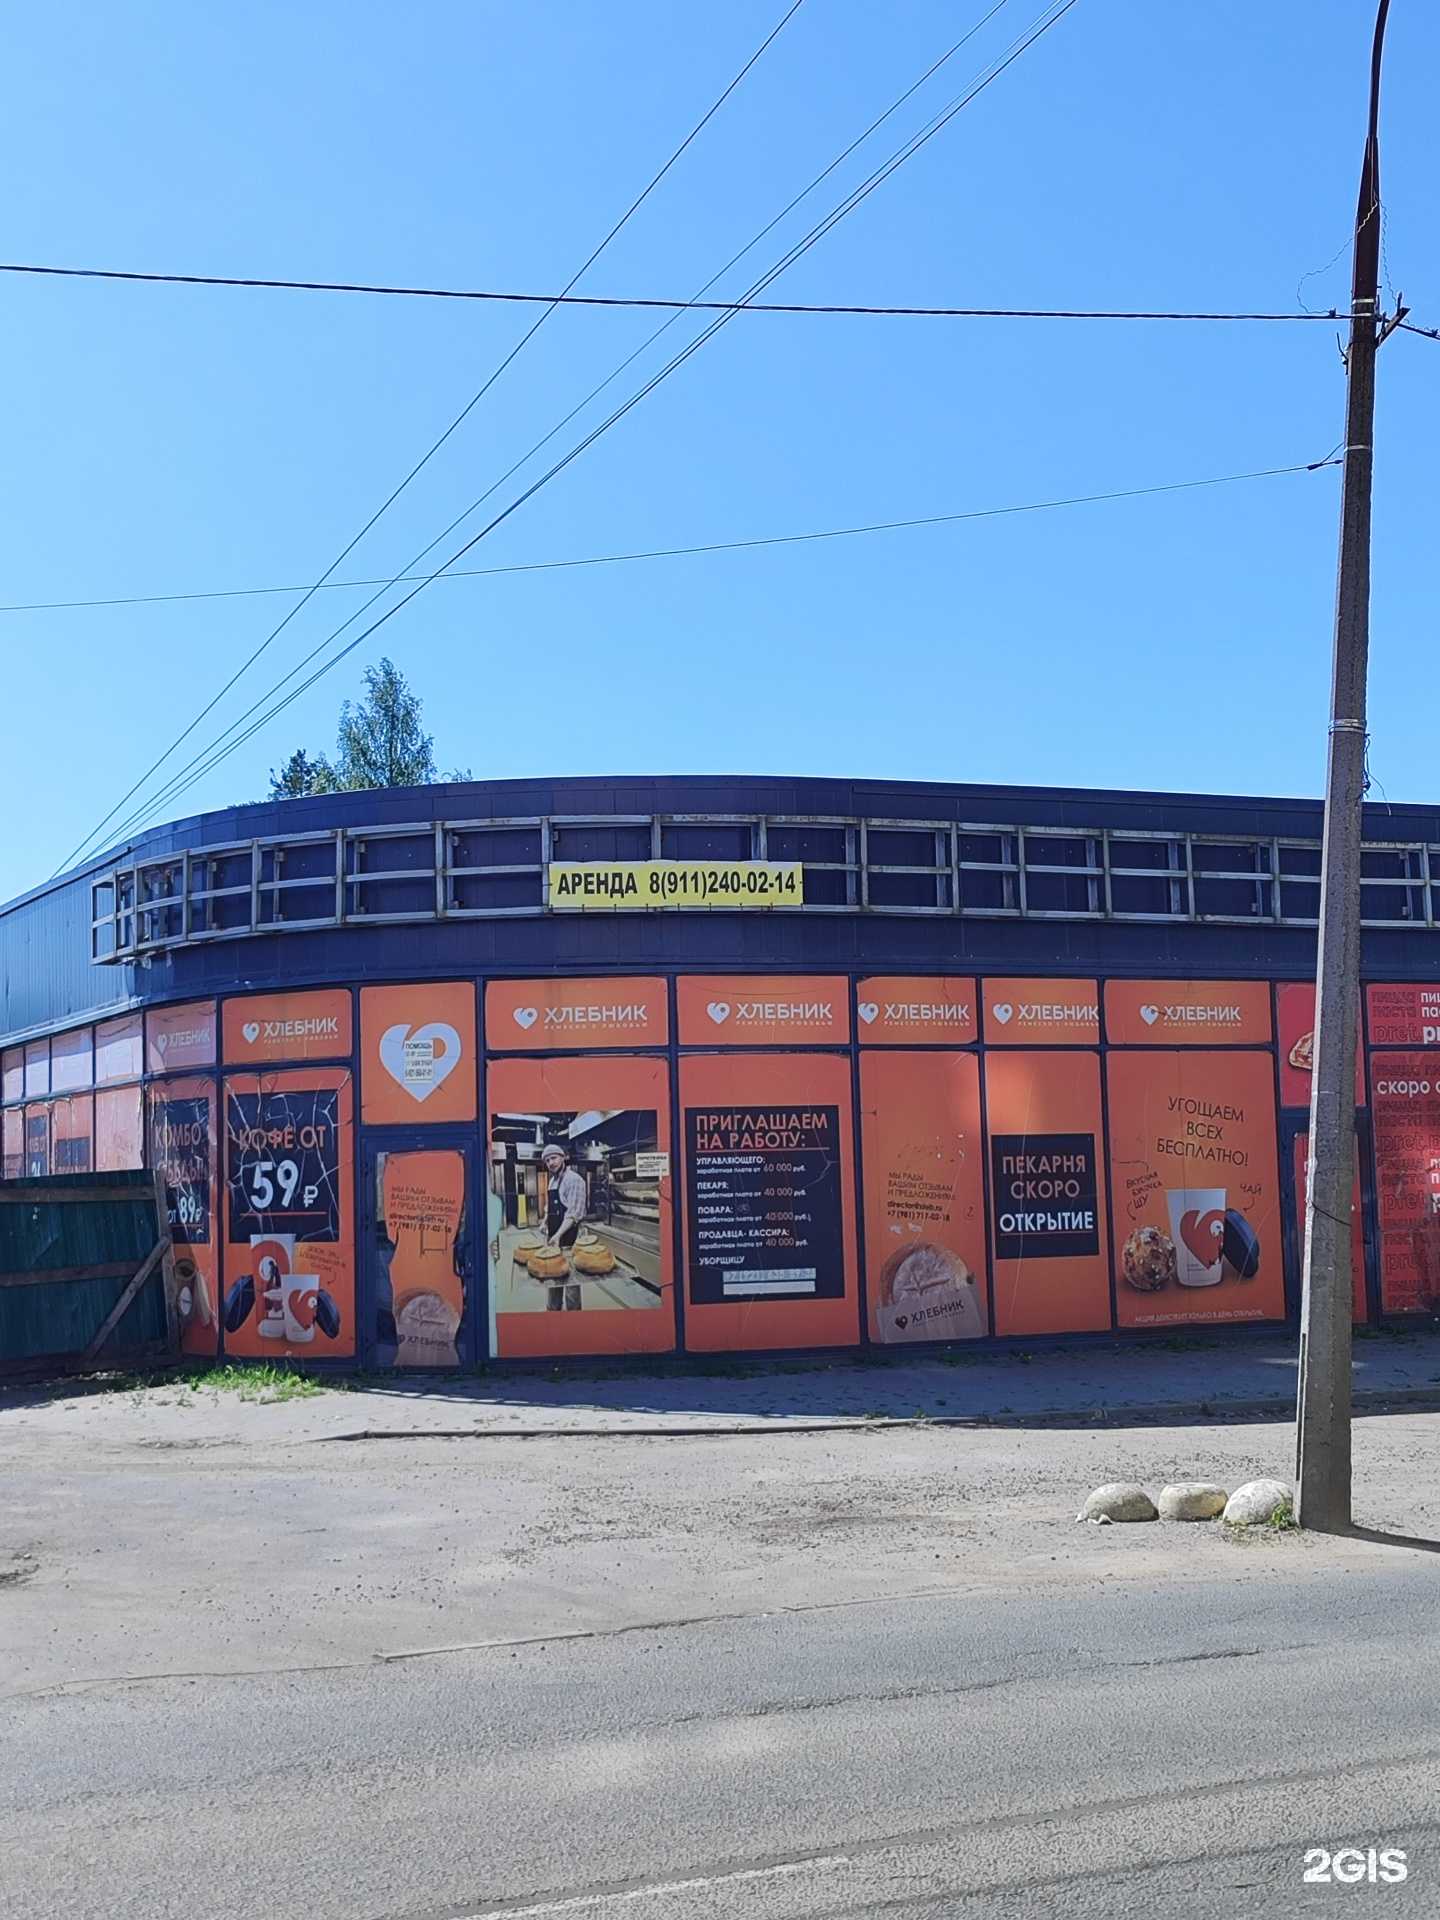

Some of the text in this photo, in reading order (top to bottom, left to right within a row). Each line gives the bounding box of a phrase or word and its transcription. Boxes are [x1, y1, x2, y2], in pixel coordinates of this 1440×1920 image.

[557, 871, 796, 899] АРЕНДА 8(911)240-02-14
[544, 1005, 648, 1024] ХЛЕБНИК
[736, 1003, 832, 1019] ХЛЕБНИК
[885, 1004, 970, 1019] ХЛЕБНИК
[1018, 1004, 1099, 1020] ХЛЕБНИК
[1163, 1006, 1242, 1021] ХЛЕБНИК
[264, 1017, 338, 1038] ХЛЕБНИК
[168, 1028, 210, 1047] ХЛЕБНИК
[1377, 1081, 1431, 1098] скоро
[1168, 1096, 1244, 1122] УГОЩАЕМ
[696, 1113, 828, 1131] ПРИГЛАШАЕМ
[1187, 1121, 1223, 1140] ВСЕХ
[154, 1123, 201, 1149] КОМБО
[240, 1126, 326, 1150] КОФЕ ОТ
[696, 1131, 806, 1149] НА РАБОТУ:
[696, 1156, 765, 1165] УПРАВЛЯЮЩЕГО:
[1157, 1138, 1248, 1166] БЕСПЛАТНО!
[1003, 1155, 1086, 1174] ПЕКАРНЯ
[251, 1159, 298, 1209] 59
[697, 1182, 729, 1190] ПЕКАРЯ:
[1011, 1180, 1080, 1199] СКОРО
[1240, 1183, 1262, 1195] ЧАЙ
[698, 1206, 733, 1214] ПОВАРА:
[1000, 1211, 1094, 1232] ОТКРЫТИЕ
[749, 1228, 790, 1237] КАССИРА:
[699, 1256, 744, 1265] УБОРЩИЦУ
[911, 1300, 964, 1323] ХЛЕБНИК
